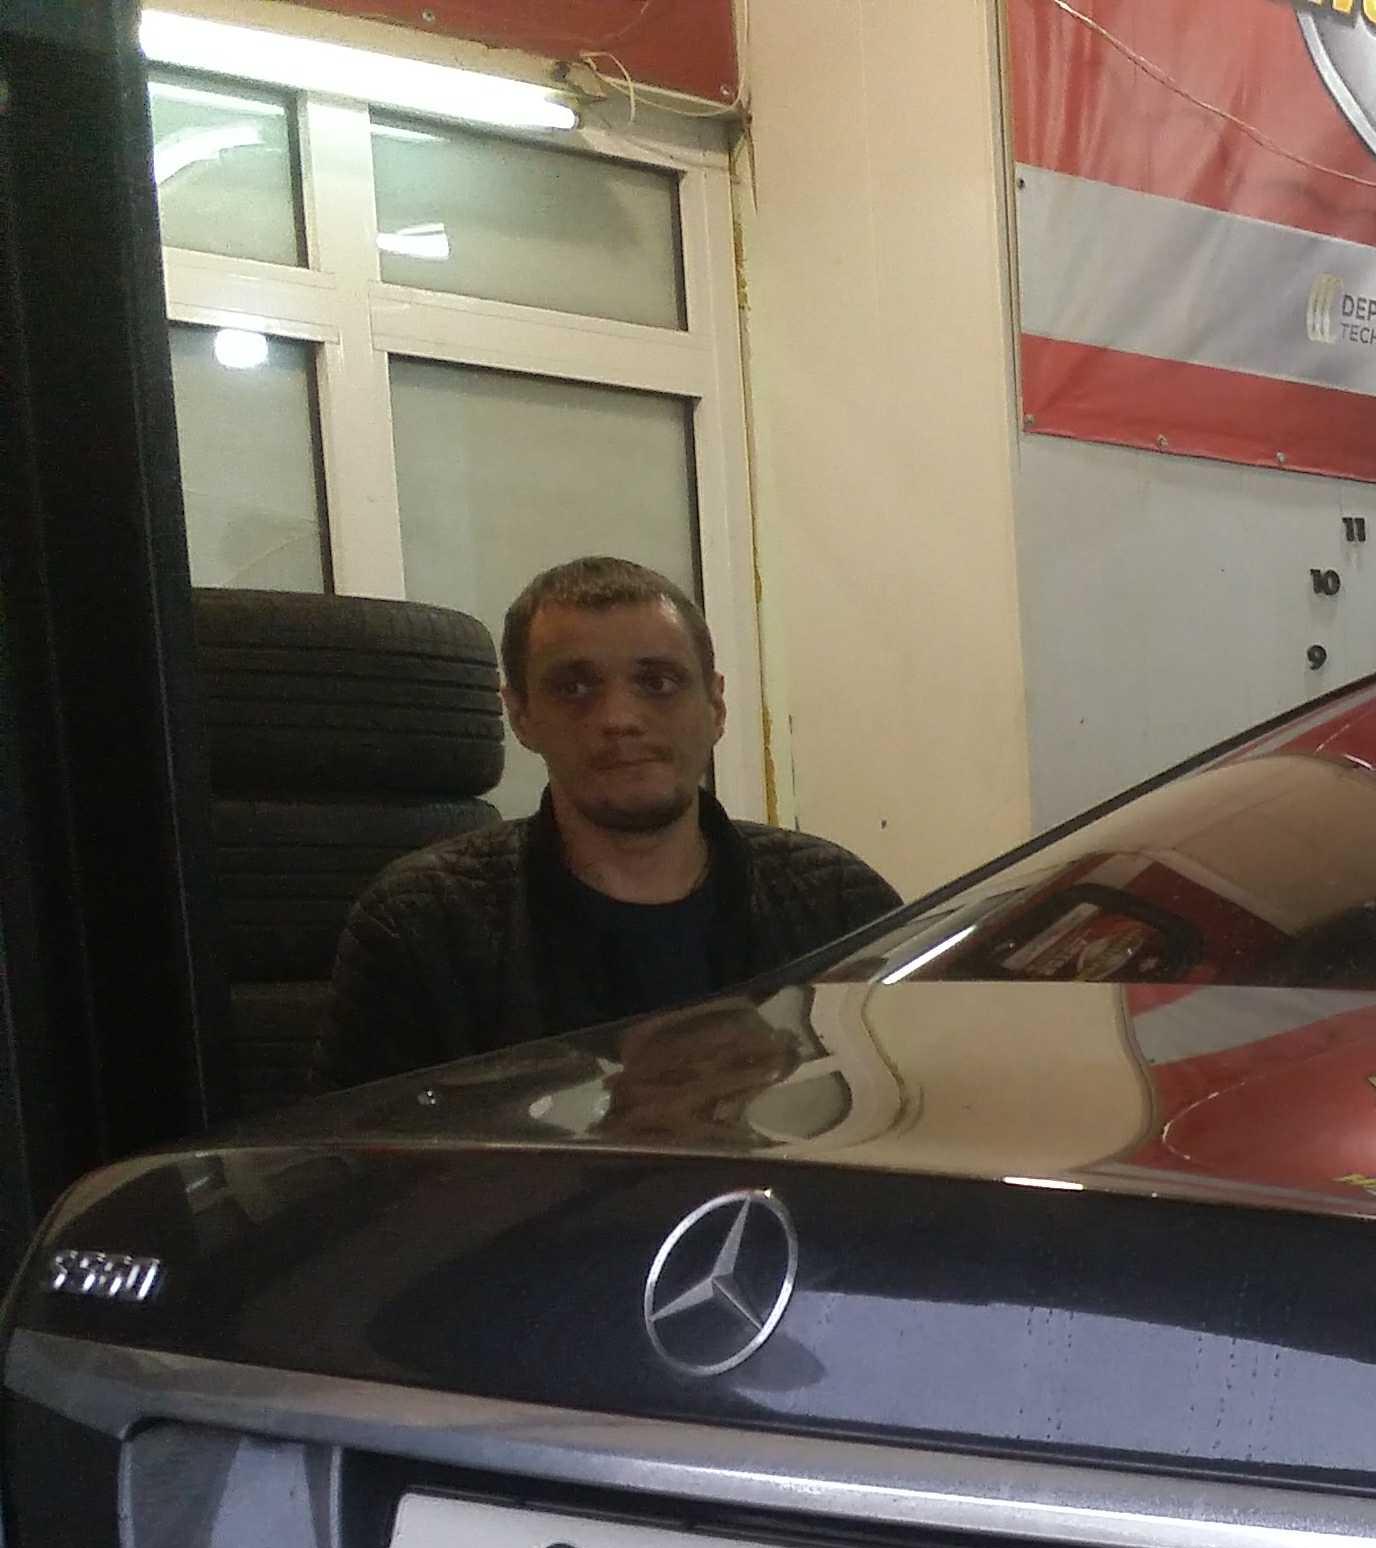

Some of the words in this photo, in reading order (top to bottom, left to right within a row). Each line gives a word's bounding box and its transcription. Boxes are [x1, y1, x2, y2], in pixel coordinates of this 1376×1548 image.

[1341, 516, 1366, 542] 11
[1309, 568, 1341, 596] 10
[1306, 644, 1327, 671] 9
